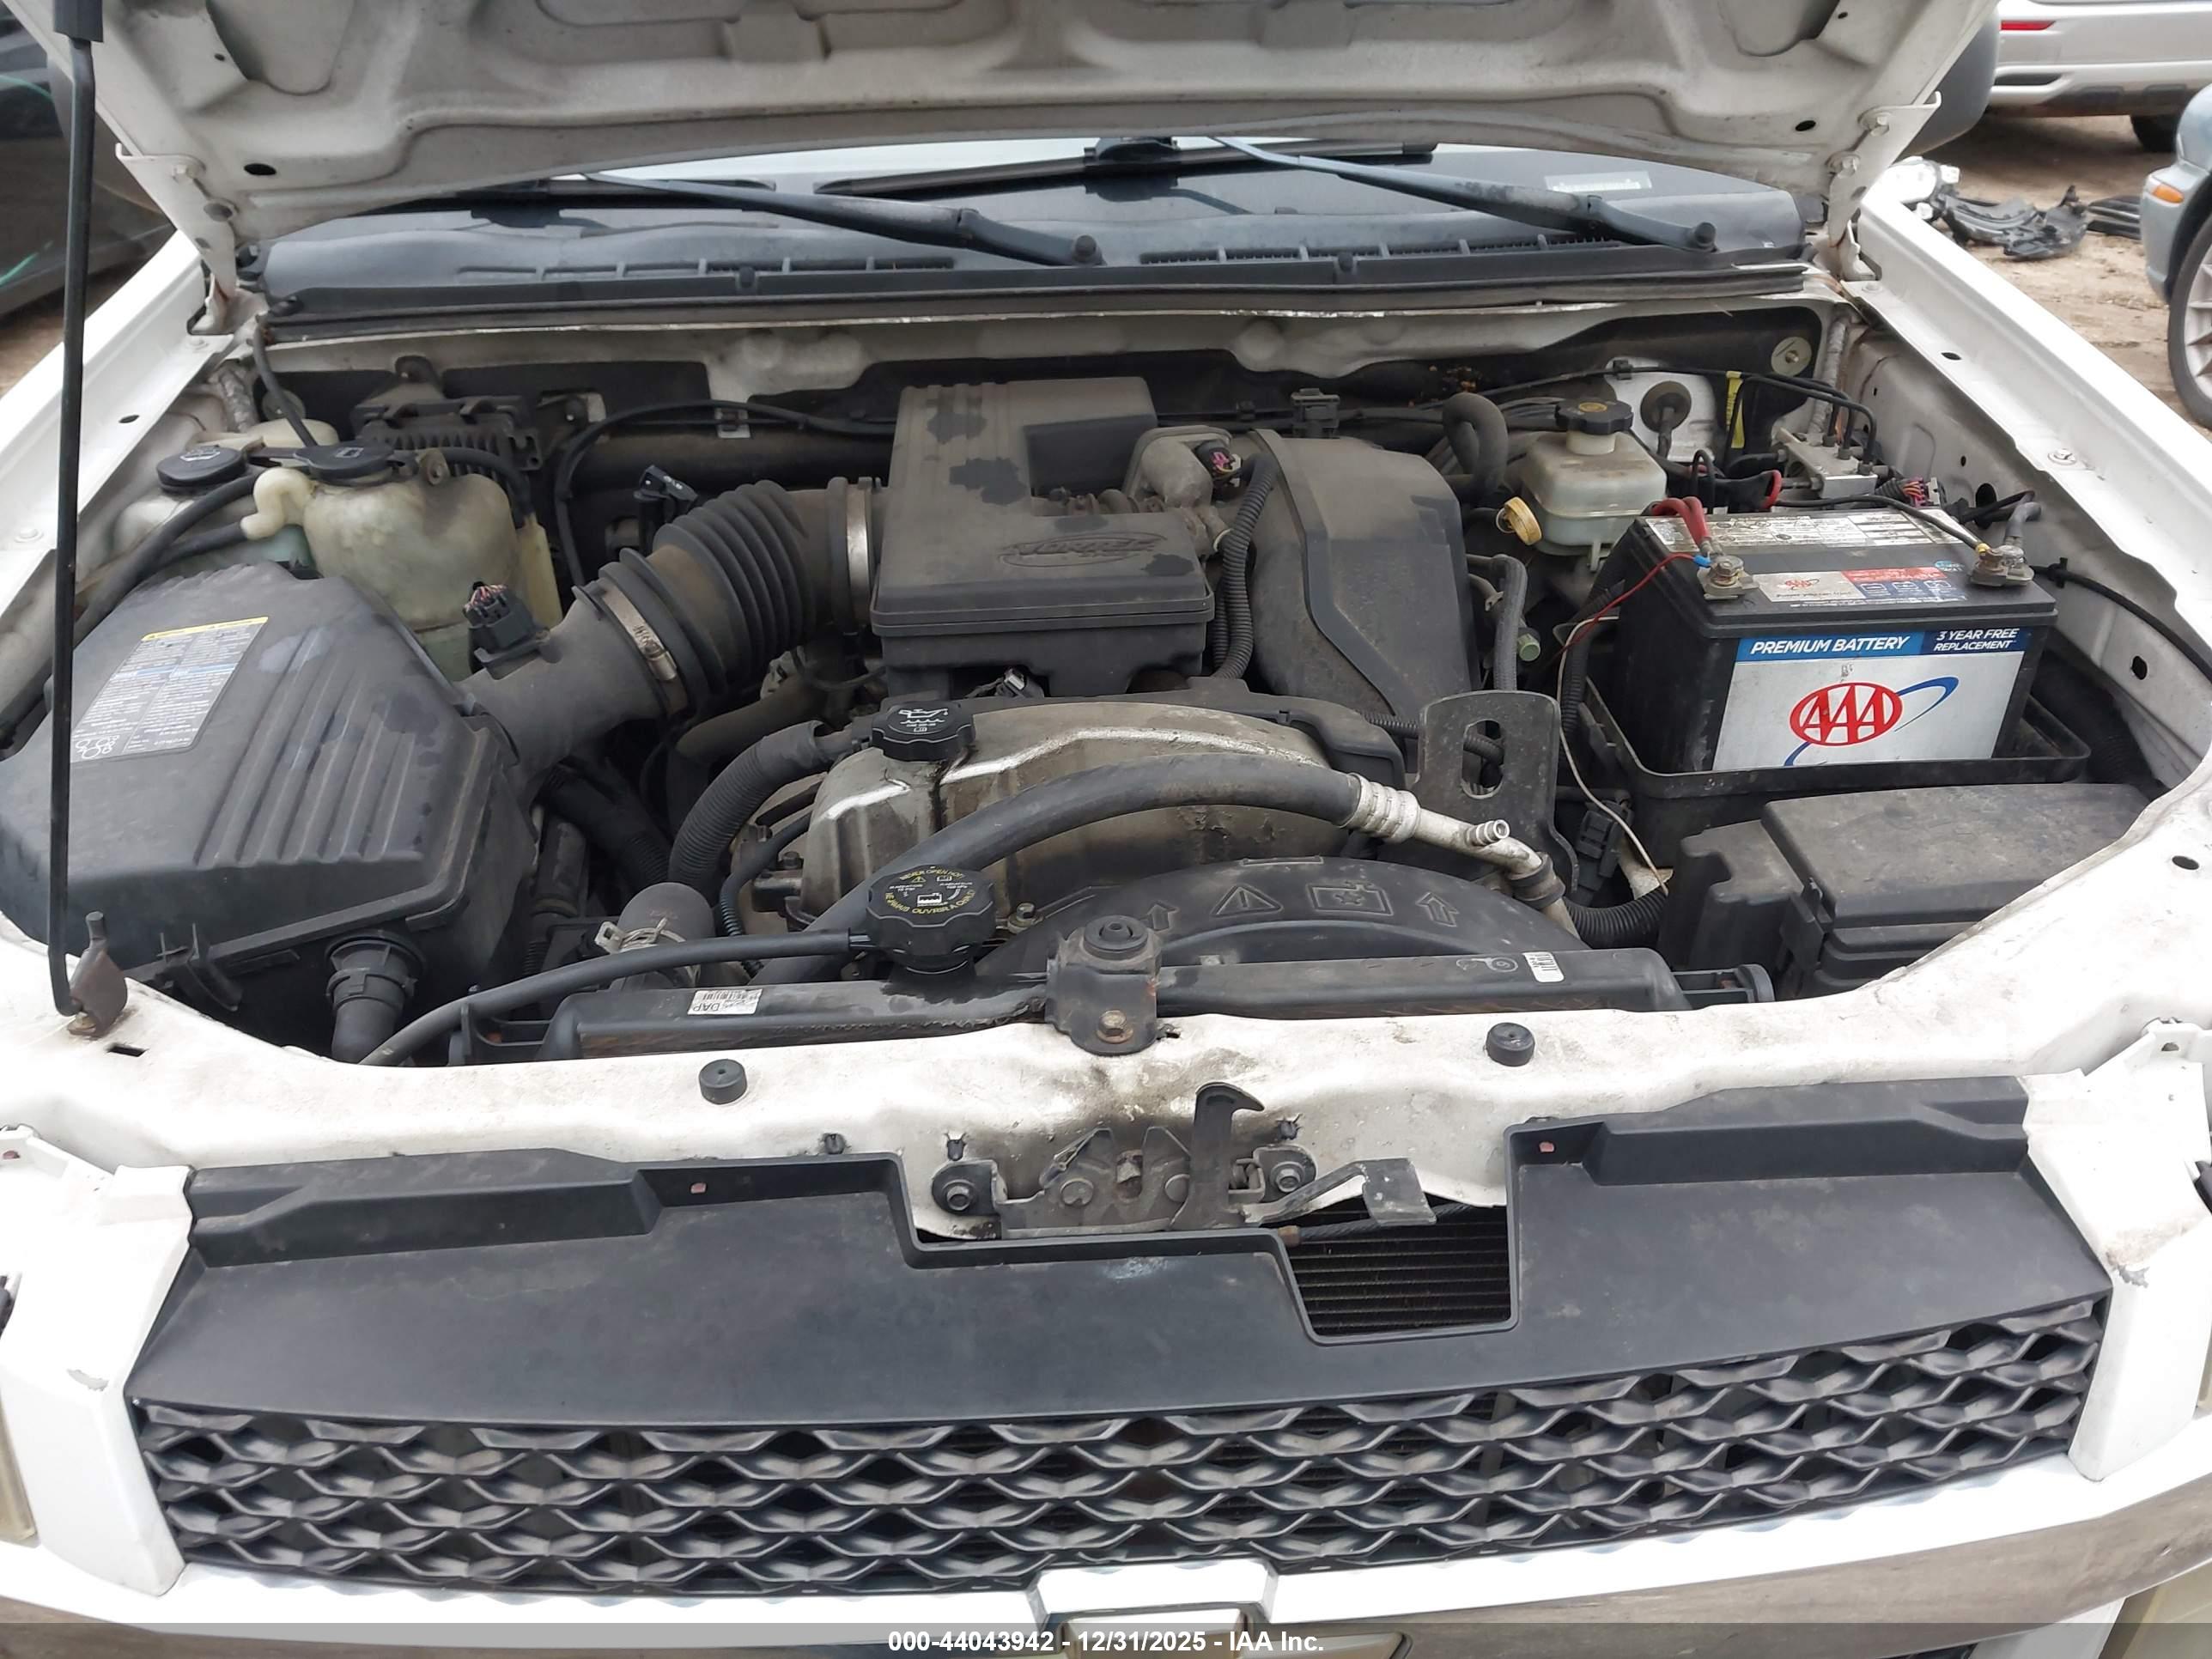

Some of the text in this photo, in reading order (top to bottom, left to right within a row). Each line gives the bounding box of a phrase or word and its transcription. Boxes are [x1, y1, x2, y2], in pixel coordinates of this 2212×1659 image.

[1936, 628, 2020, 641] 3 YEAR FREE
[1750, 635, 1910, 654] PREMIUM BATTERY
[1934, 640, 2013, 652] REPLACEMENT
[1797, 684, 1894, 744] AAA
